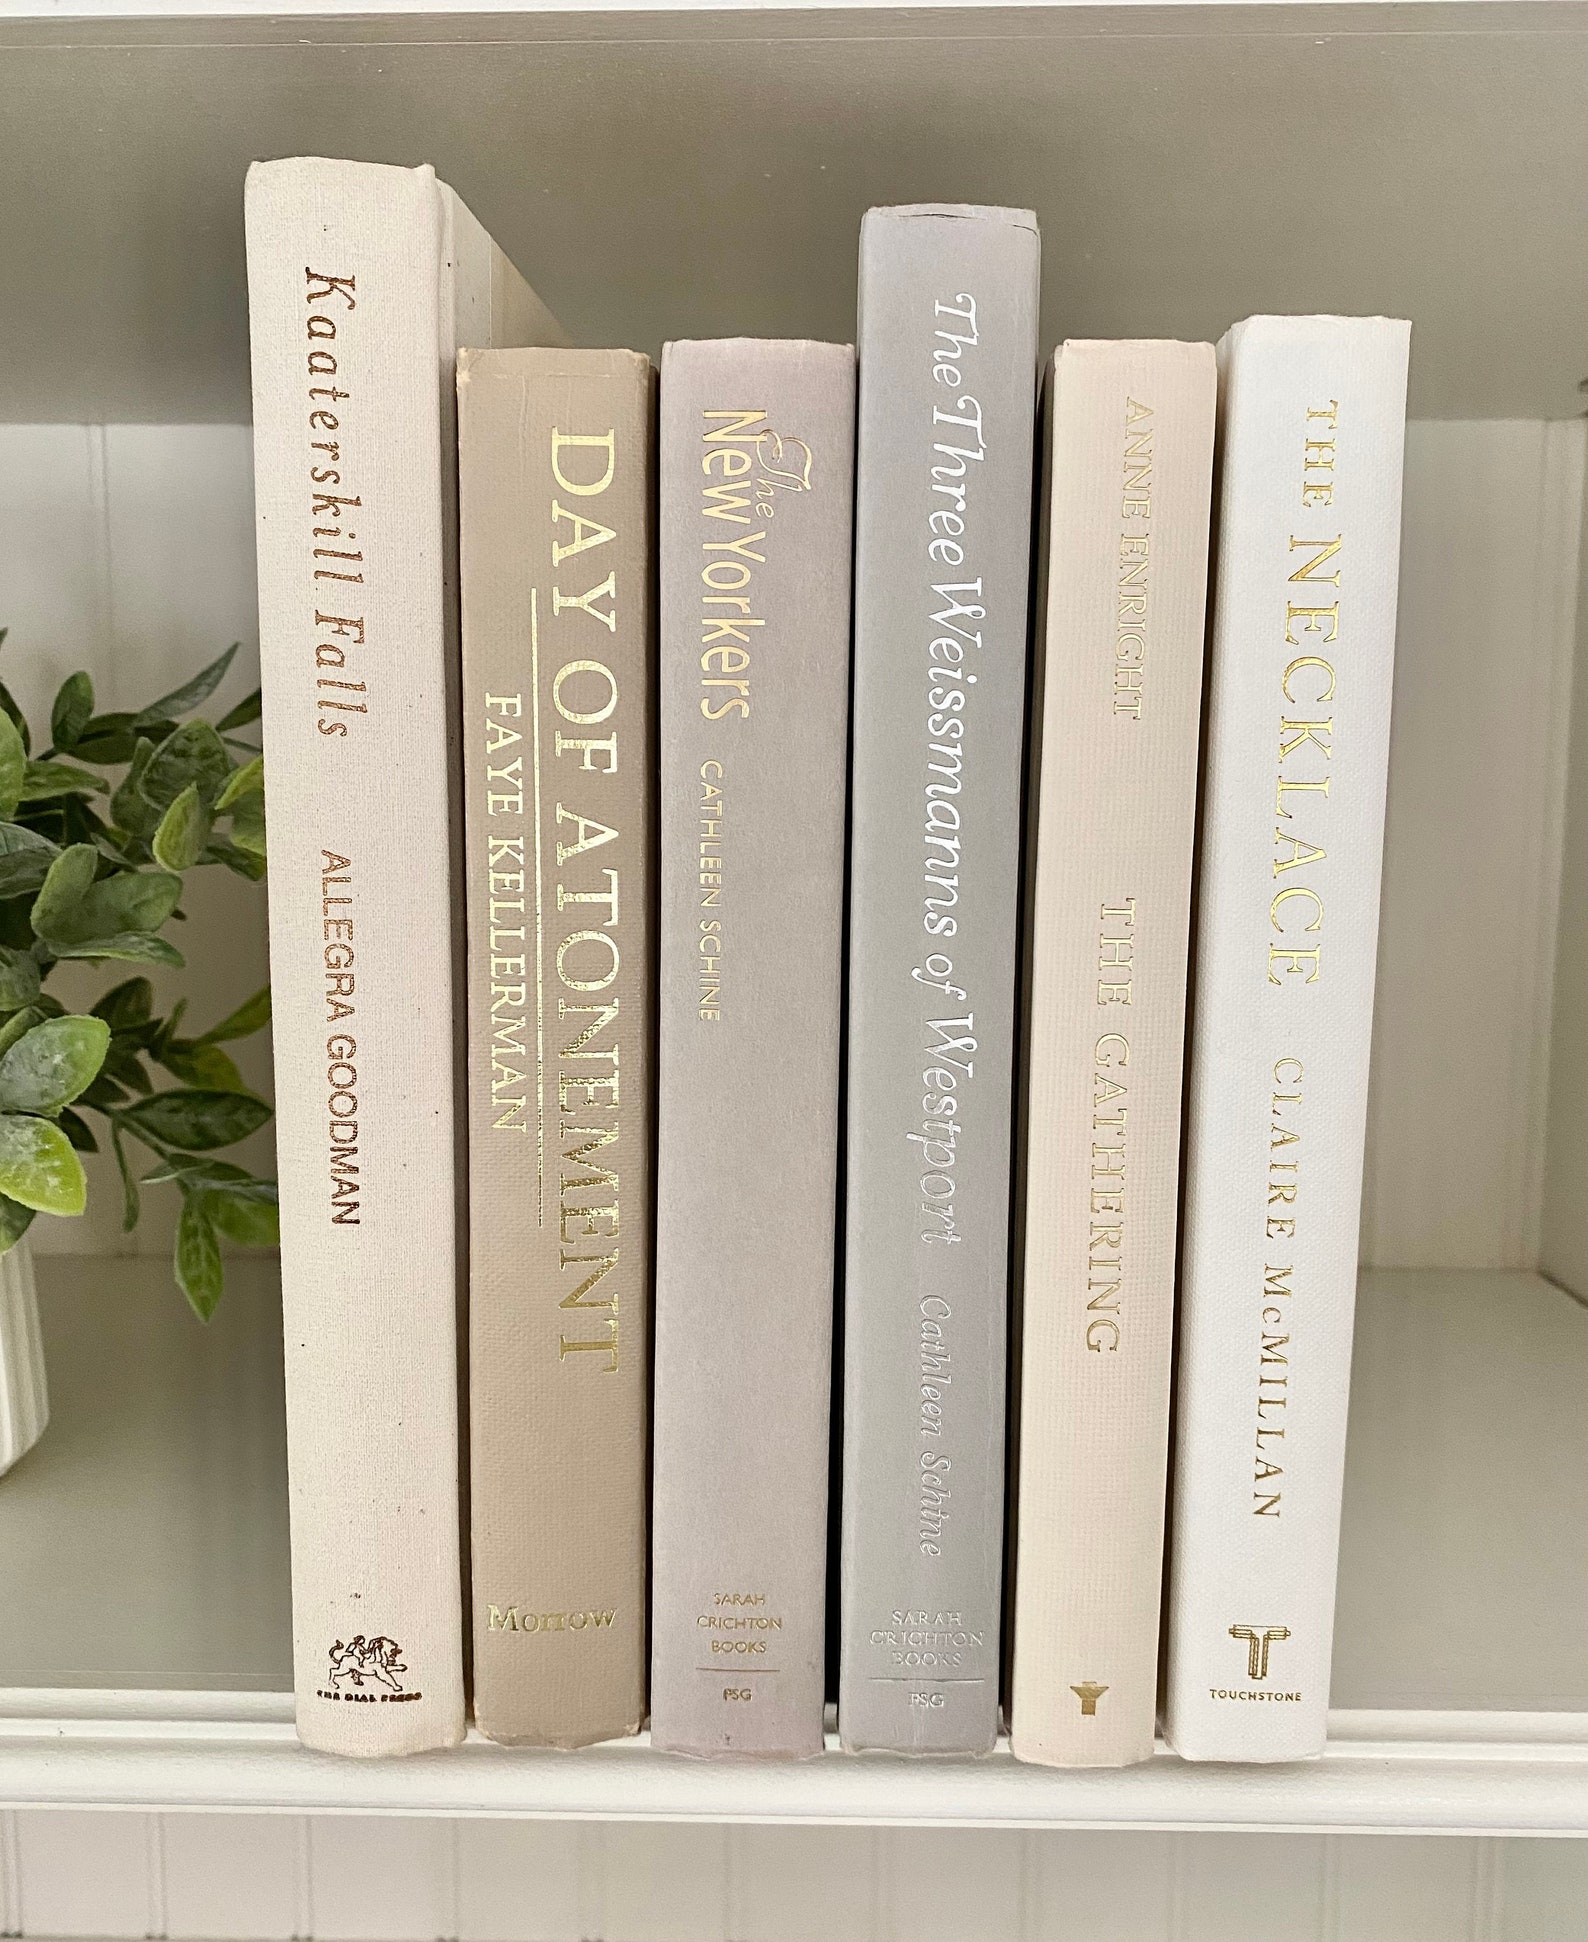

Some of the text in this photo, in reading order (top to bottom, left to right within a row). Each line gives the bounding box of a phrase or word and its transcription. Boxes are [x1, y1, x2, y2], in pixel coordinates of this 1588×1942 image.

[304, 266, 369, 738] Kaaterskill Falls
[700, 408, 768, 721] New Yorkers
[757, 428, 814, 520] The
[1112, 396, 1155, 721] ANNE ENRIGHT
[906, 292, 987, 1245] The Three Weissmanns of Westport
[1267, 400, 1343, 987] THE NECKLACE
[484, 692, 529, 1134] FAYE KELLERMAN
[549, 426, 622, 1374] DAY OF ATONEMENT
[697, 759, 723, 1022] CATHLEEN SCHINE
[320, 849, 362, 1226] ALLEGRA GOODMAN
[1085, 897, 1137, 1353] THE GATHERING
[1252, 1057, 1305, 1518] CLAIRE McMILLAN
[919, 1294, 951, 1556] Cathleen Schine
[487, 1604, 617, 1633] Morrow
[697, 1615, 782, 1630] CRICHTON
[711, 1640, 767, 1653] BOOKS
[714, 1593, 766, 1606] SARAH
[723, 1688, 753, 1701] FSG
[869, 1631, 984, 1647] CRICHTON
[891, 1652, 963, 1667] BOOKS
[892, 1610, 963, 1626] SARAH
[909, 1692, 945, 1708] FSG
[1209, 1688, 1302, 1702] TOUCHSTONE
